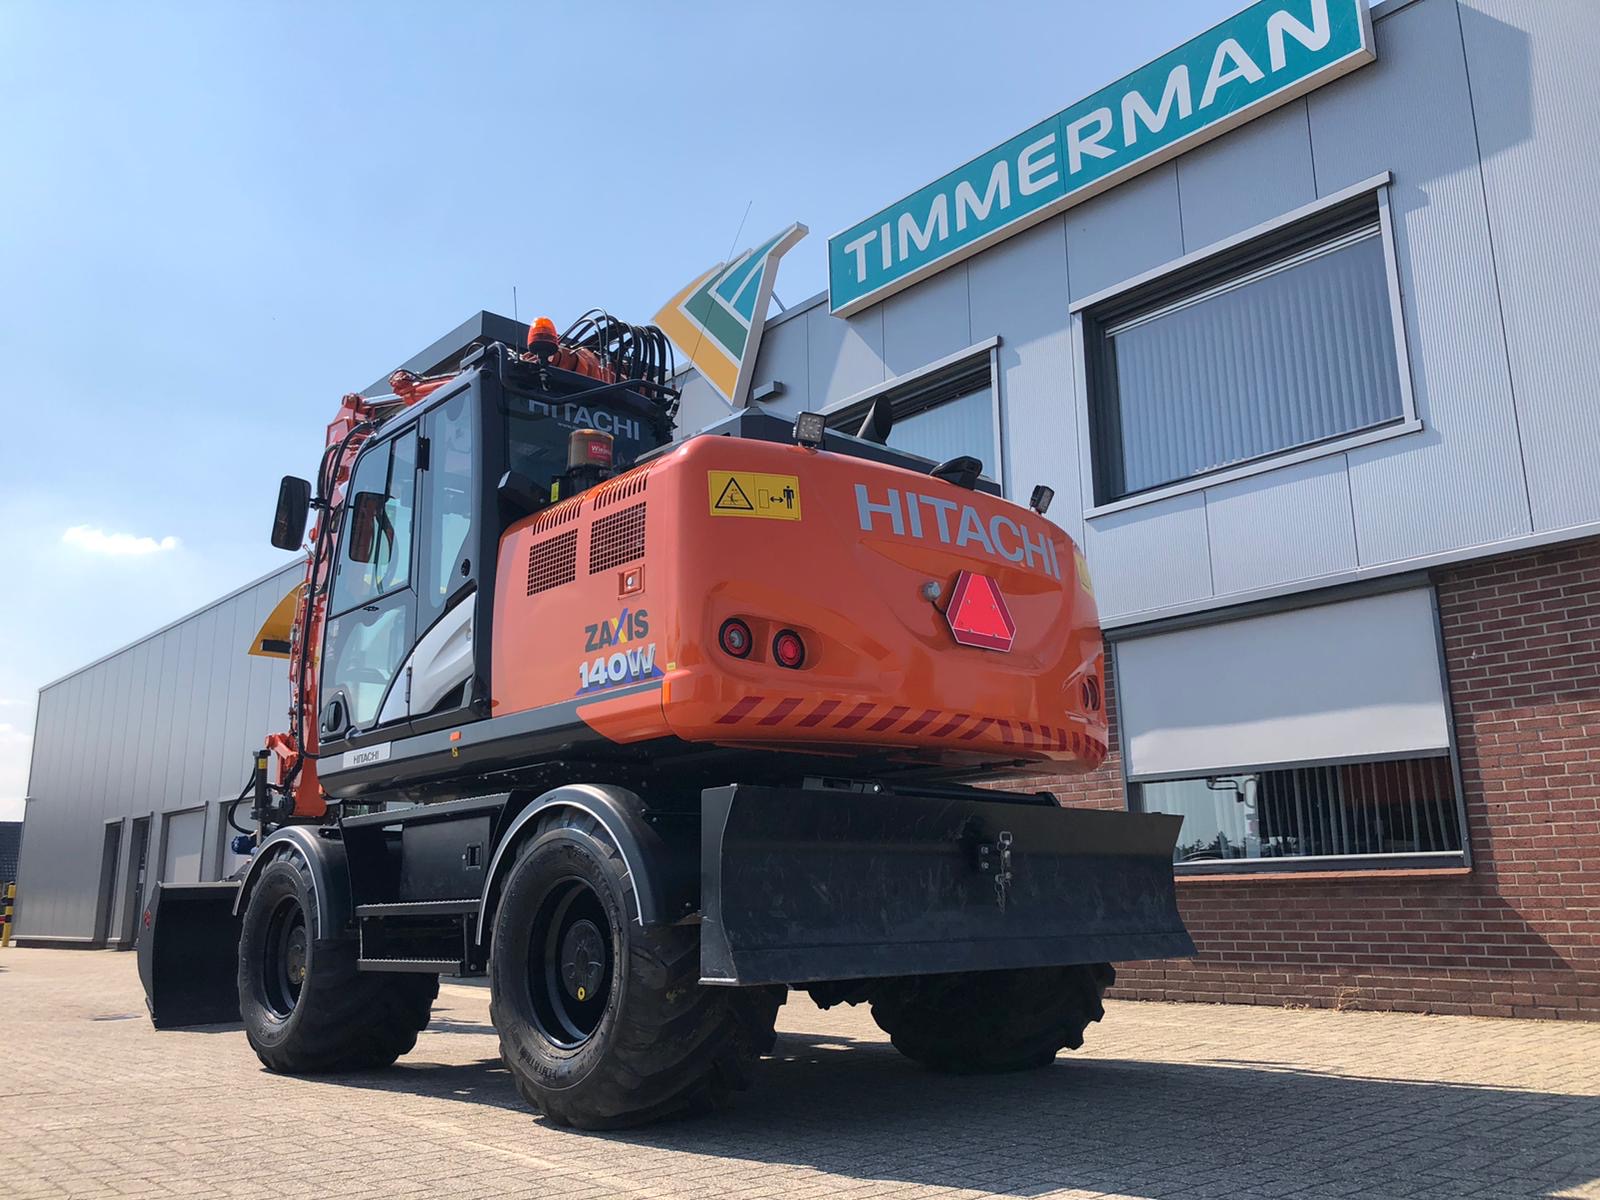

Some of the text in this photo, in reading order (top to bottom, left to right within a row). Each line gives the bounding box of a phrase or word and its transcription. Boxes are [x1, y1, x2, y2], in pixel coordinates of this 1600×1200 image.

[844, 0, 1332, 284] TIMMERMAN
[529, 399, 639, 440] HITACHI
[854, 483, 1062, 580] HITACHI
[585, 608, 649, 652] ZAXIS
[579, 643, 656, 688] 140W
[353, 751, 380, 764] HITACHI
